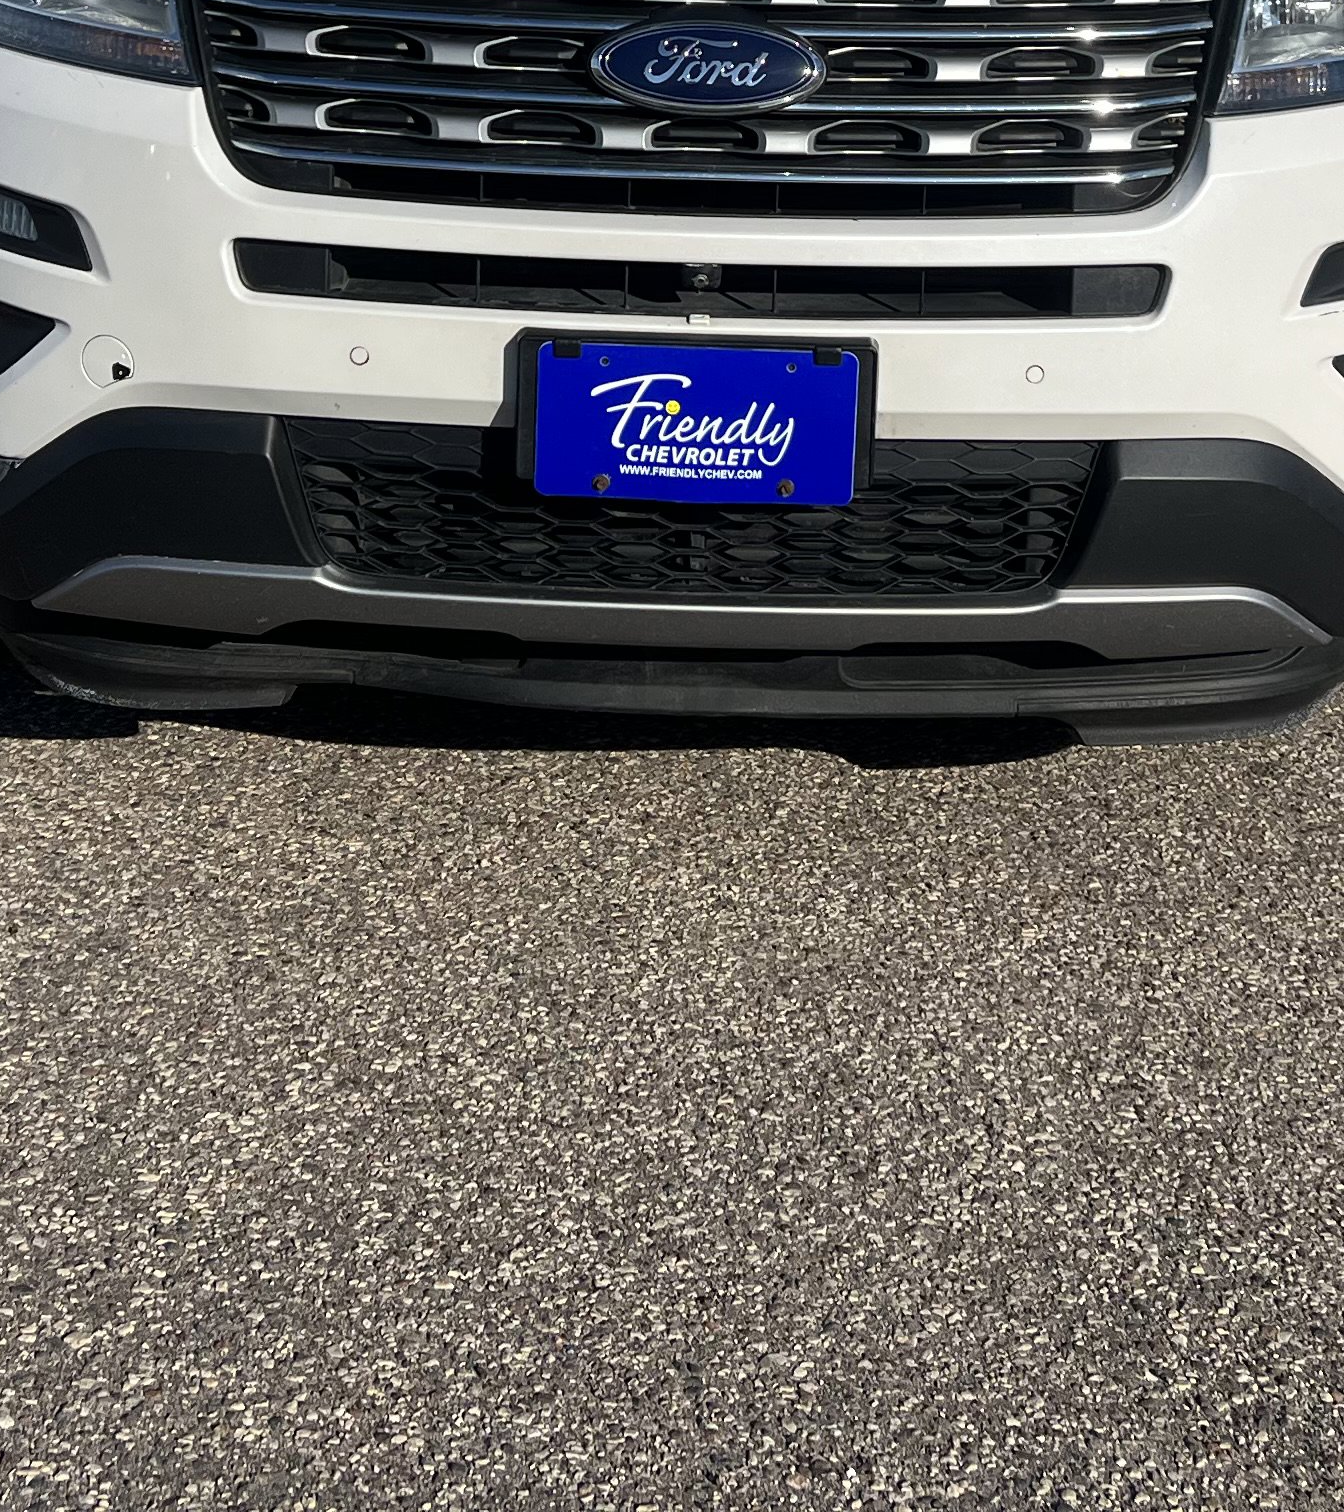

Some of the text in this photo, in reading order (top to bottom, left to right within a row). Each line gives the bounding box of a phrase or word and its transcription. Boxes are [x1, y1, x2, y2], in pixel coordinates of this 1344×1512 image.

[643, 36, 769, 87] Ford
[590, 373, 795, 467] Friendly
[619, 463, 763, 481] WWW.FRIENDLYCHEV.COM
[625, 444, 756, 467] CHEVROLET
